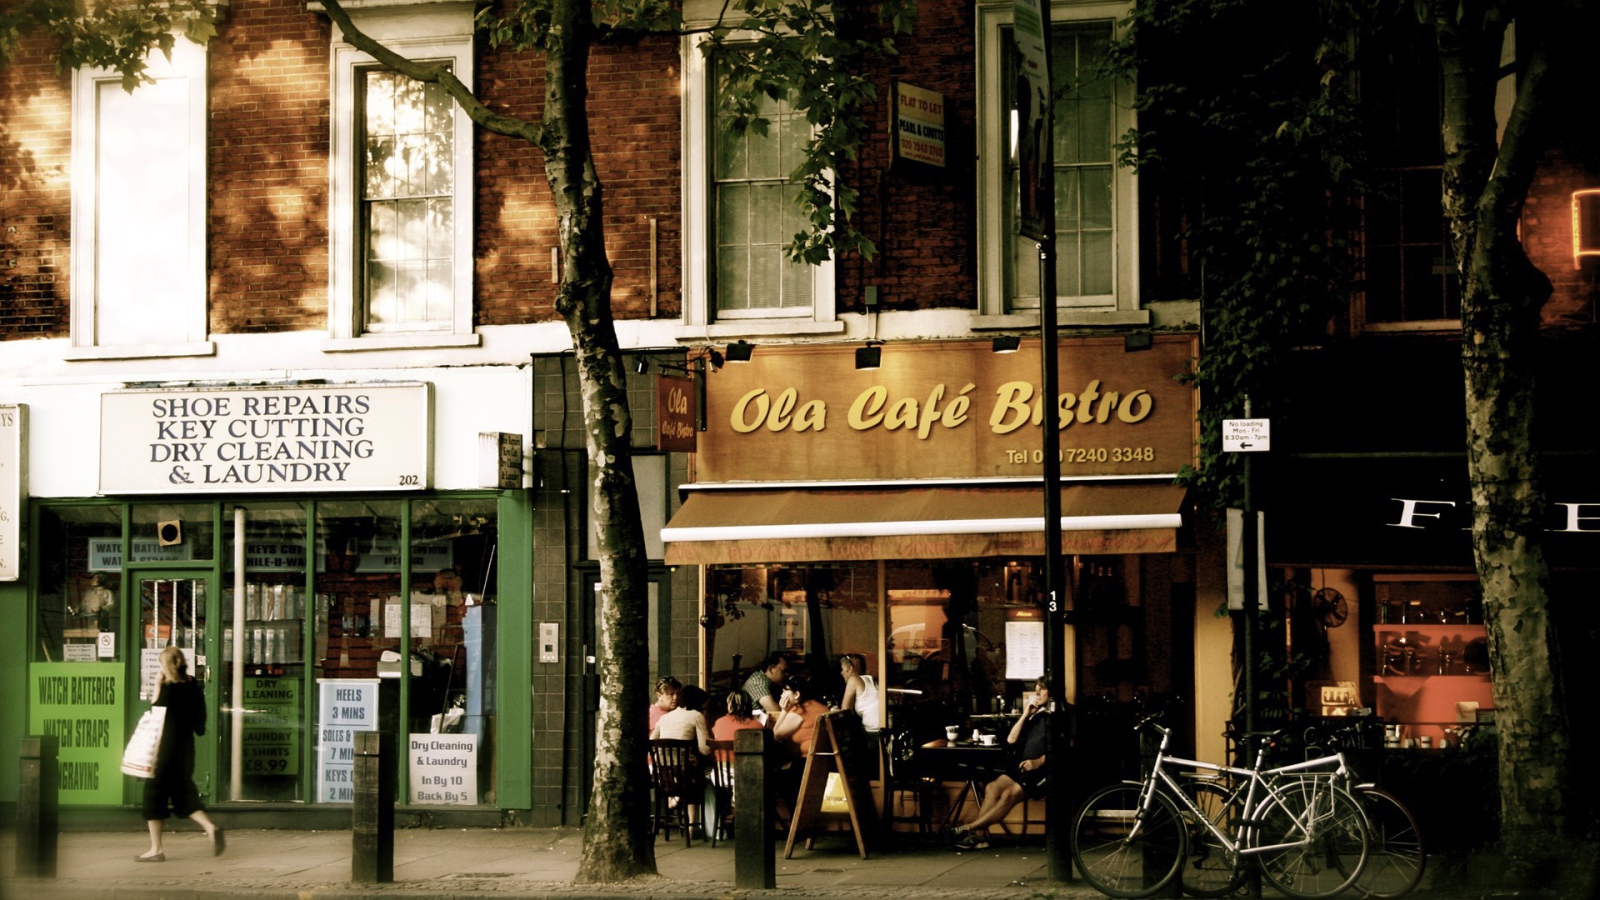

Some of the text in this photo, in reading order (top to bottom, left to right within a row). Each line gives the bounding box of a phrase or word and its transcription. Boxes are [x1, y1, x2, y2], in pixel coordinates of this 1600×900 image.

[901, 94, 942, 115] FLAT TO LET
[899, 119, 917, 135] PEARL
[153, 395, 370, 418] SHOE REPAIRS
[668, 387, 687, 415] Ola
[730, 387, 827, 433] Ola
[847, 382, 977, 440] Café
[156, 417, 365, 440] KEY CUTTING
[149, 439, 374, 462] DRY CLEANING
[1006, 450, 1028, 464] Tel
[1067, 448, 1108, 463] 7240
[1112, 447, 1154, 462] 3348
[168, 462, 351, 485] & LAUNDRY
[399, 475, 419, 486] 202
[96, 544, 122, 553] WATC
[248, 545, 302, 554] KEYS CUT
[39, 677, 115, 705] WATCH BATTERIES
[256, 680, 277, 689] DRY
[336, 689, 362, 702] HEELS
[333, 707, 365, 720] 3 MINS
[76, 719, 109, 748] STRAPS
[323, 729, 343, 742] SOLES
[346, 730, 350, 742] &
[253, 748, 289, 757] SHIRTS
[411, 741, 473, 752] Dry Cleaning
[331, 748, 336, 760] 7
[417, 756, 467, 768] & Laundry
[58, 762, 99, 790] NGRAVING
[325, 769, 347, 782] KEYS
[422, 776, 462, 787] In By 10
[330, 788, 335, 800] 2
[418, 791, 441, 800] Back
[445, 792, 458, 802] By
